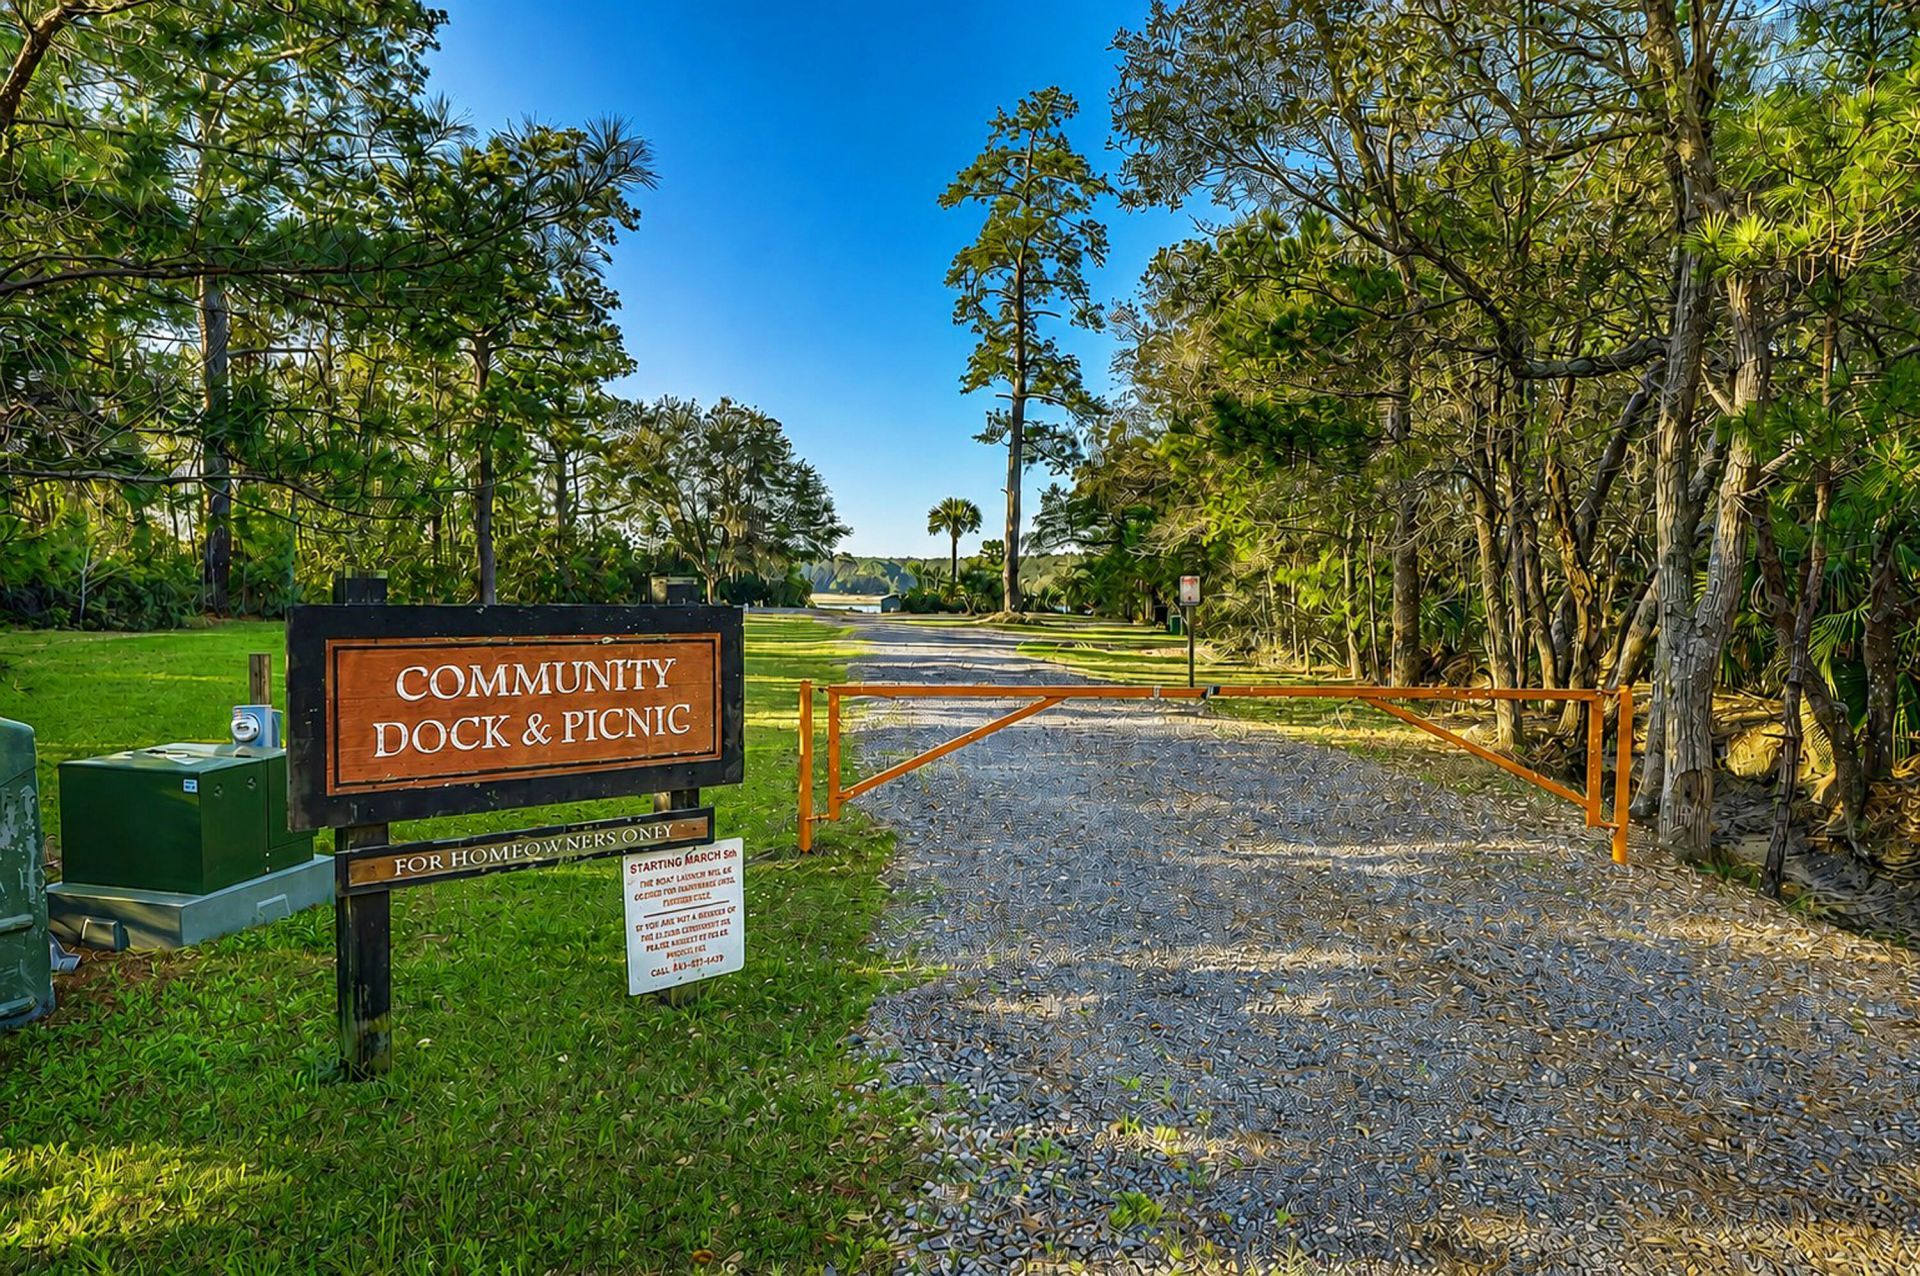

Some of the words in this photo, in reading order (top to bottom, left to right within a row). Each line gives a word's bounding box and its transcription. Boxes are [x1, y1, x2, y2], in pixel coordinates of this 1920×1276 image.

[395, 658, 677, 702] COMMUNITY
[373, 714, 511, 758] DOCK
[521, 713, 552, 746] &
[561, 703, 691, 743] PICNIC
[394, 853, 444, 876] FOR
[450, 830, 616, 867] HOMEOWNERS
[622, 824, 673, 844] ONLY
[630, 857, 682, 874] STARTING
[685, 850, 721, 866] MARCH
[651, 966, 670, 977] CALL
